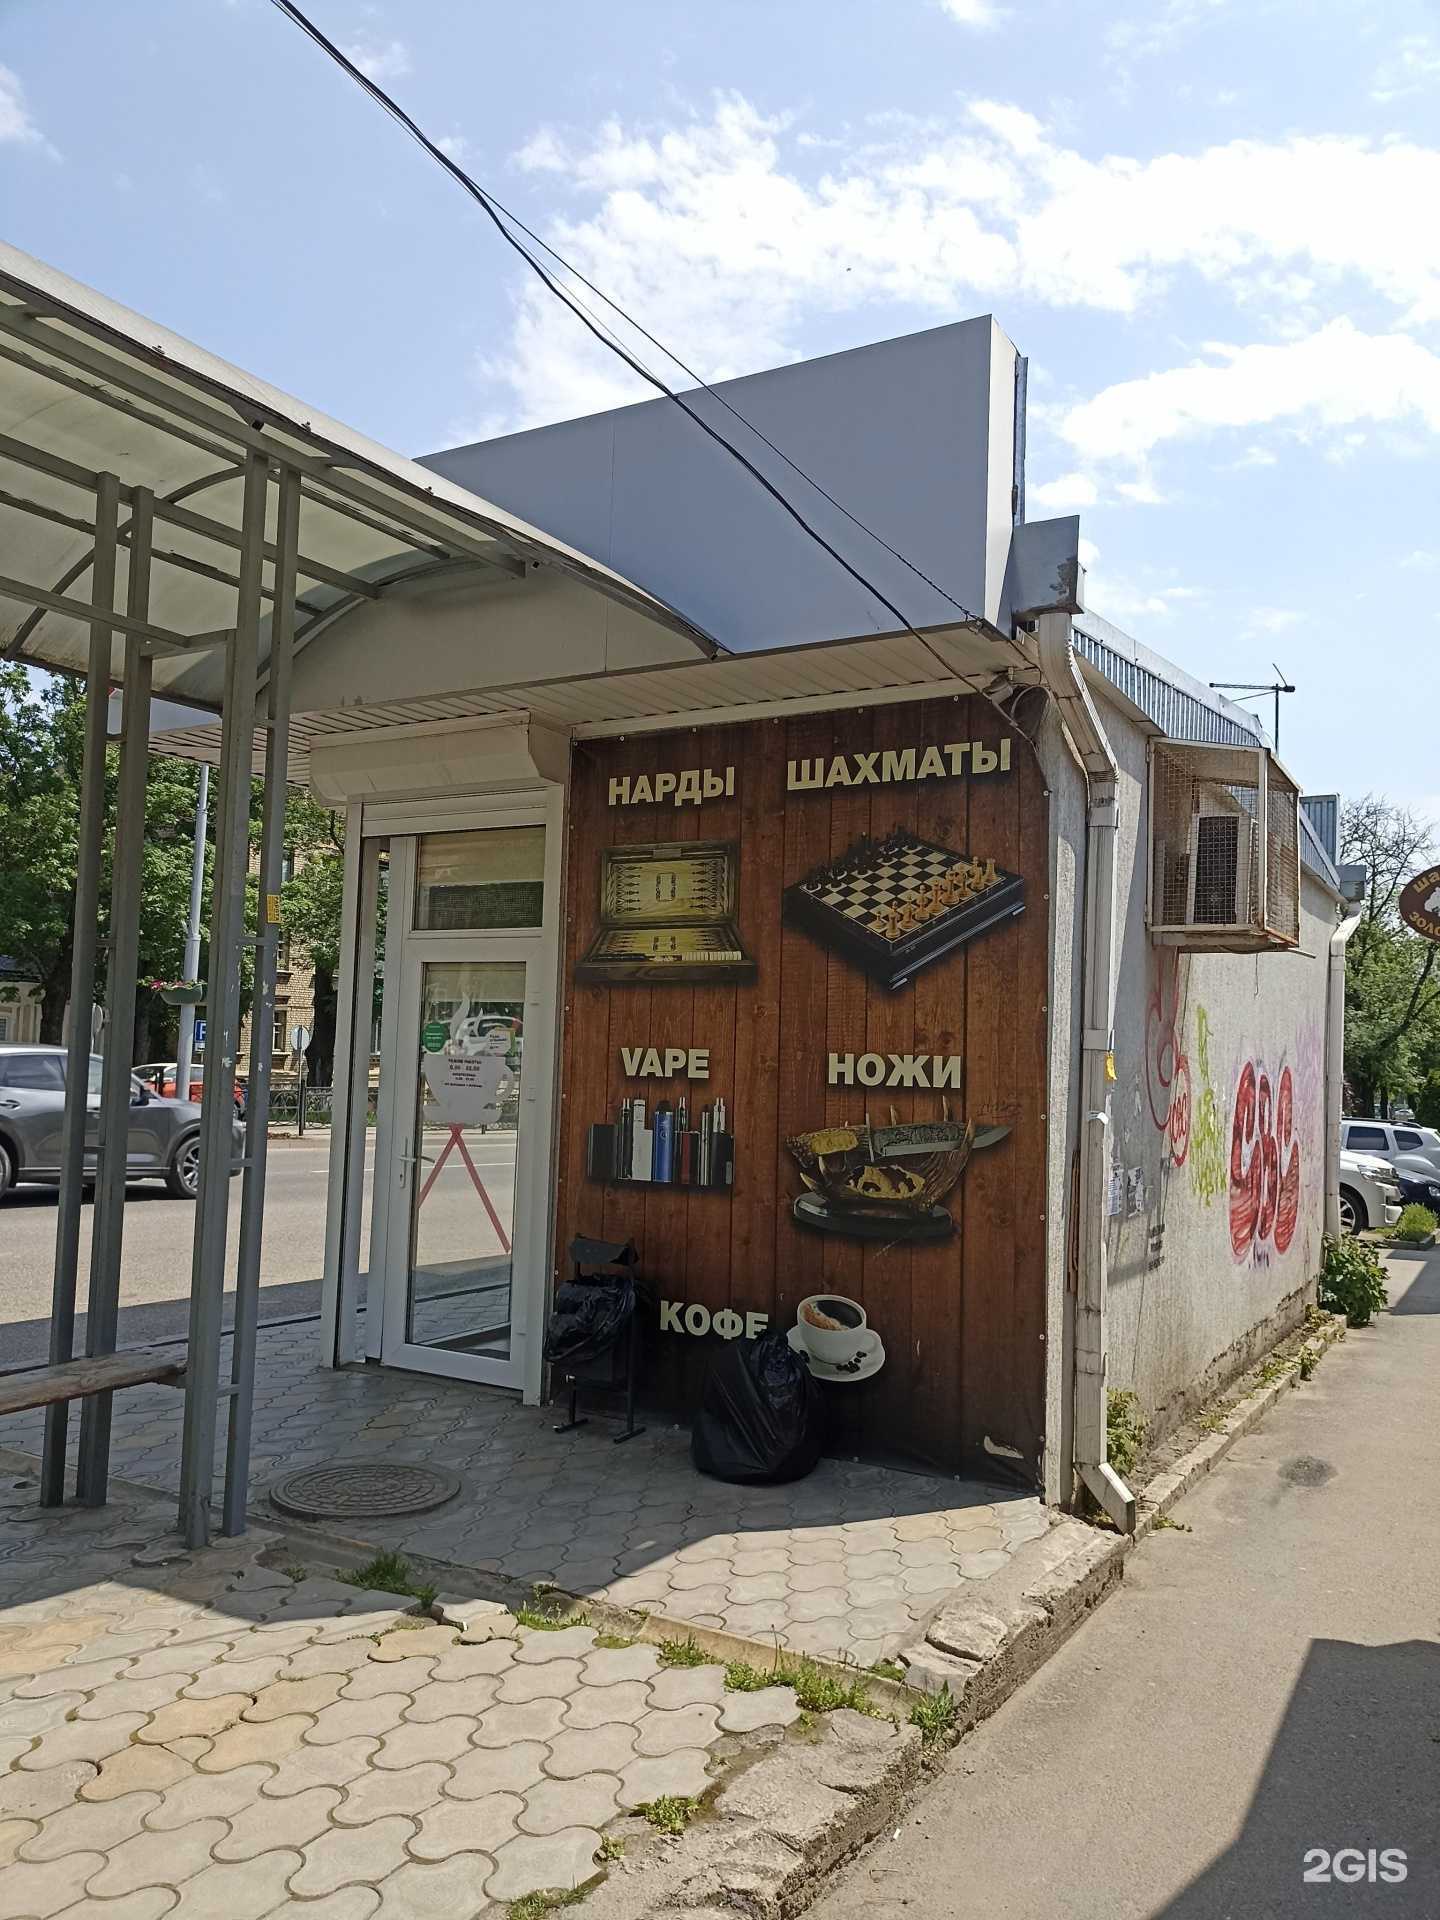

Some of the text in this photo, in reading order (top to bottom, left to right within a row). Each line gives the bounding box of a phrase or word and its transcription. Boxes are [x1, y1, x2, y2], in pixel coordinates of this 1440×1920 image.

[786, 738, 1011, 791] ШАХМАТЫ
[607, 766, 735, 806] НАРДЫ
[621, 1047, 710, 1079] VAPE
[828, 1052, 962, 1089] НОЖИ
[660, 1299, 769, 1340] КОФЕ
